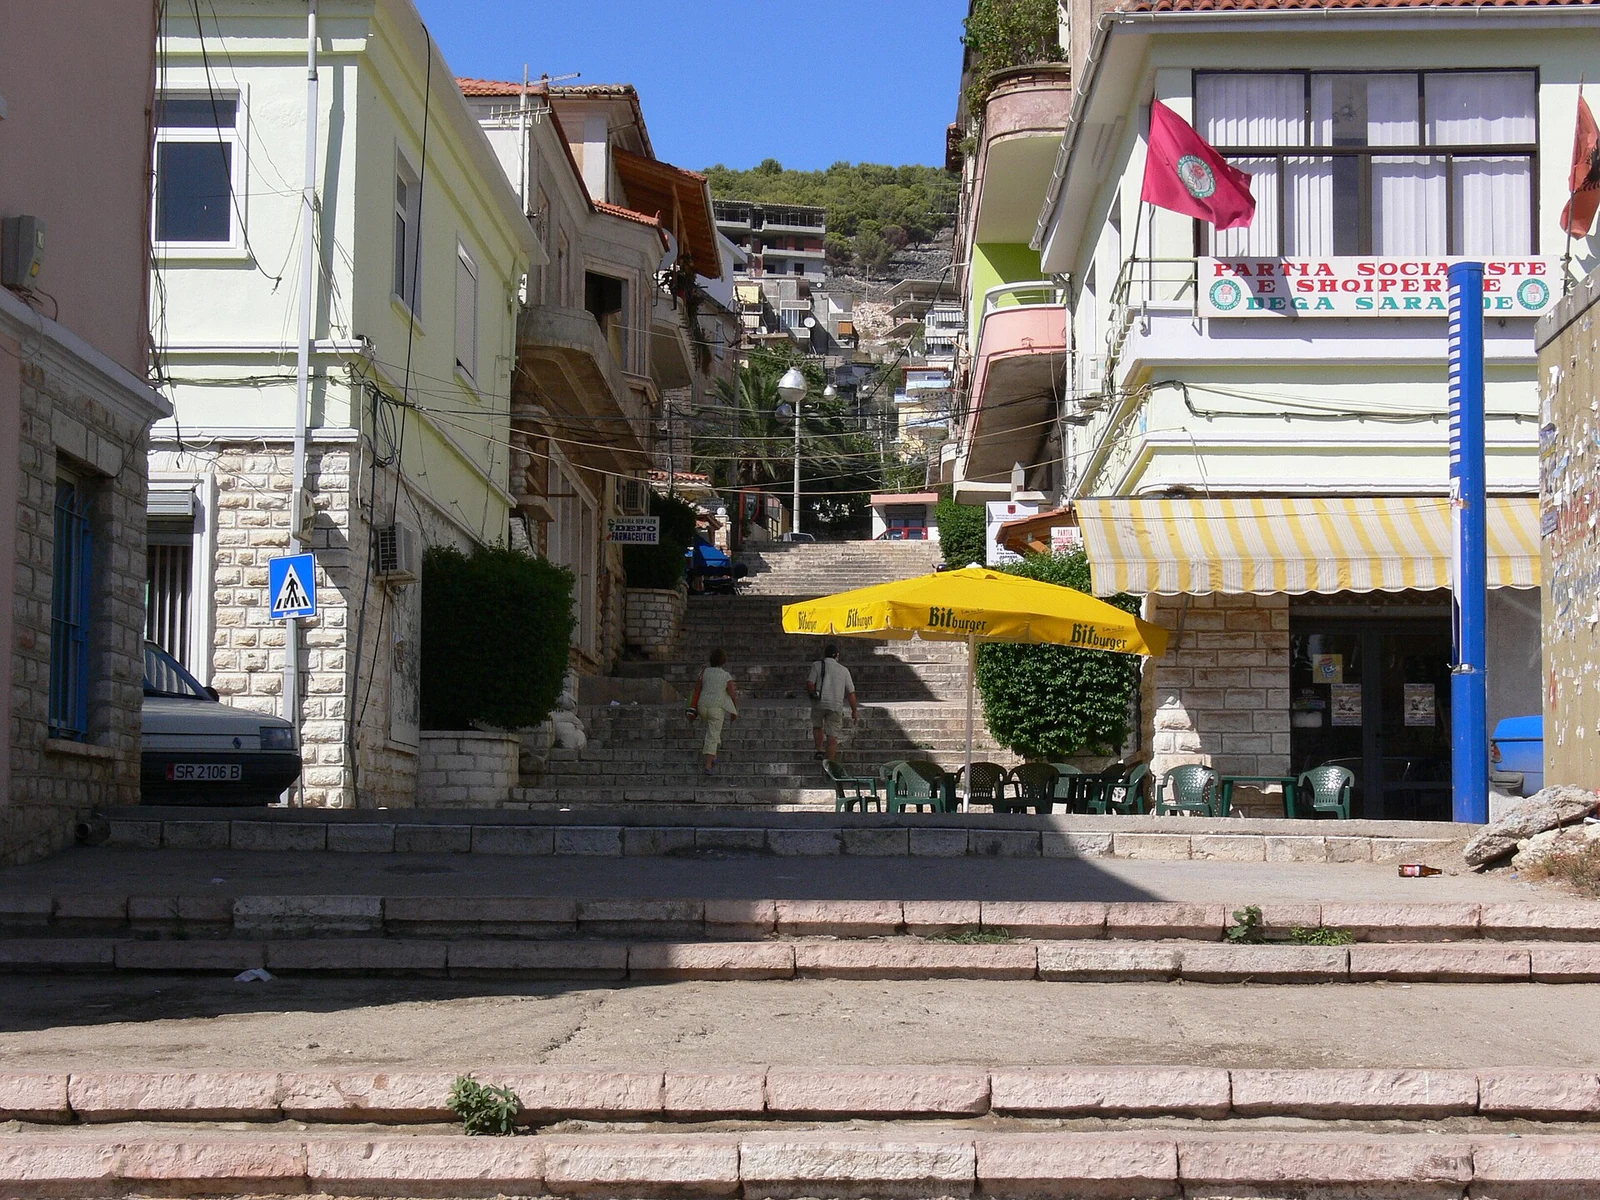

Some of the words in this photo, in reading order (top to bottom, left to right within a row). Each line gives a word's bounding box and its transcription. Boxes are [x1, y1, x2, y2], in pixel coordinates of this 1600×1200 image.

[1213, 263, 1334, 277] PARTIA
[1357, 262, 1547, 277] SOCIASTE
[1257, 279, 1276, 294] E
[1296, 279, 1502, 294] SHQIPERE
[1246, 297, 1335, 311] DEGA
[611, 532, 657, 542] FARMACEUTIKE
[846, 608, 873, 629] Bitburger
[927, 606, 987, 632] Bitburger
[1070, 623, 1127, 650] Bitburger
[176, 765, 194, 778] SR
[197, 766, 227, 779] 2106
[230, 766, 240, 779] B
